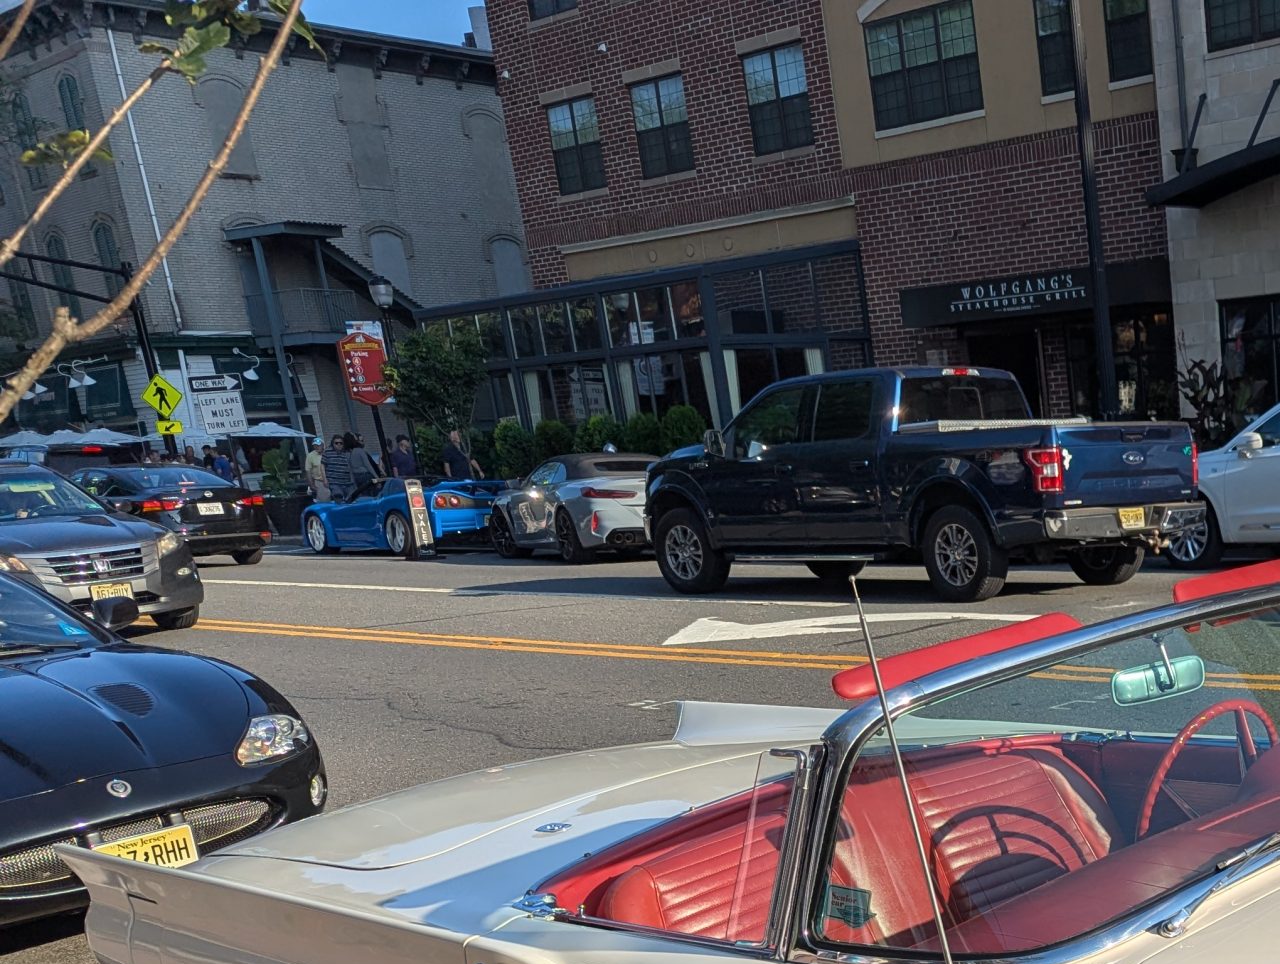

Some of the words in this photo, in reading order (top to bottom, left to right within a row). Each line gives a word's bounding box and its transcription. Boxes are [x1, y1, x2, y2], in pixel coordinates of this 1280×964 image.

[961, 274, 1073, 300] WOLFGANG'S
[950, 295, 1035, 312] STEAKHOUSE
[1045, 289, 1086, 302] GRILL
[194, 380, 210, 388] ONE
[211, 379, 226, 387] WAY
[200, 398, 217, 406] LEFT
[221, 396, 241, 405] LANE
[211, 408, 234, 418] MUST
[206, 421, 226, 430] TURN
[228, 419, 245, 428] LEFT
[417, 513, 429, 547] VALET
[117, 841, 139, 852] New
[139, 834, 168, 848] Jersey
[831, 891, 858, 905] Senior
